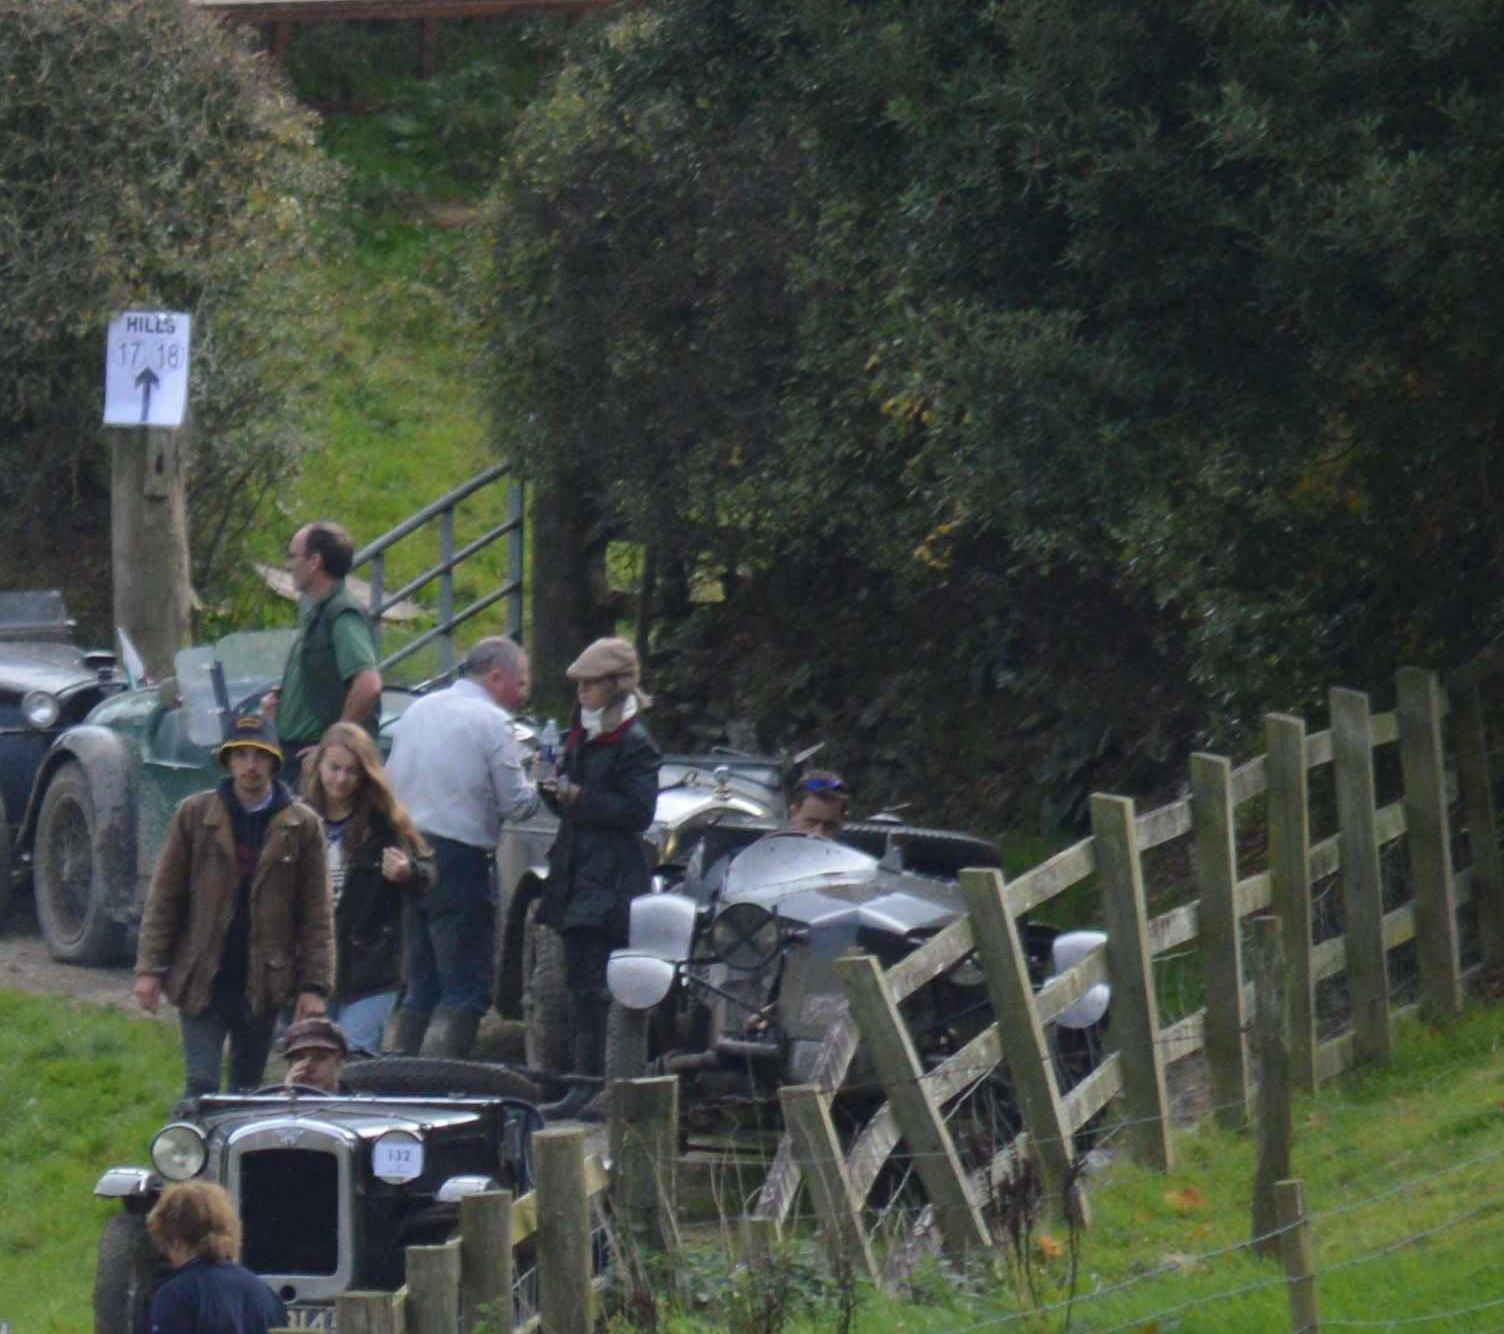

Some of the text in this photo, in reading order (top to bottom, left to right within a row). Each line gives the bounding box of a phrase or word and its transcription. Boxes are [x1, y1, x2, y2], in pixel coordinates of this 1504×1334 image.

[126, 315, 176, 334] HILLS
[118, 342, 179, 369] 17 18
[389, 1150, 411, 1162] 132
